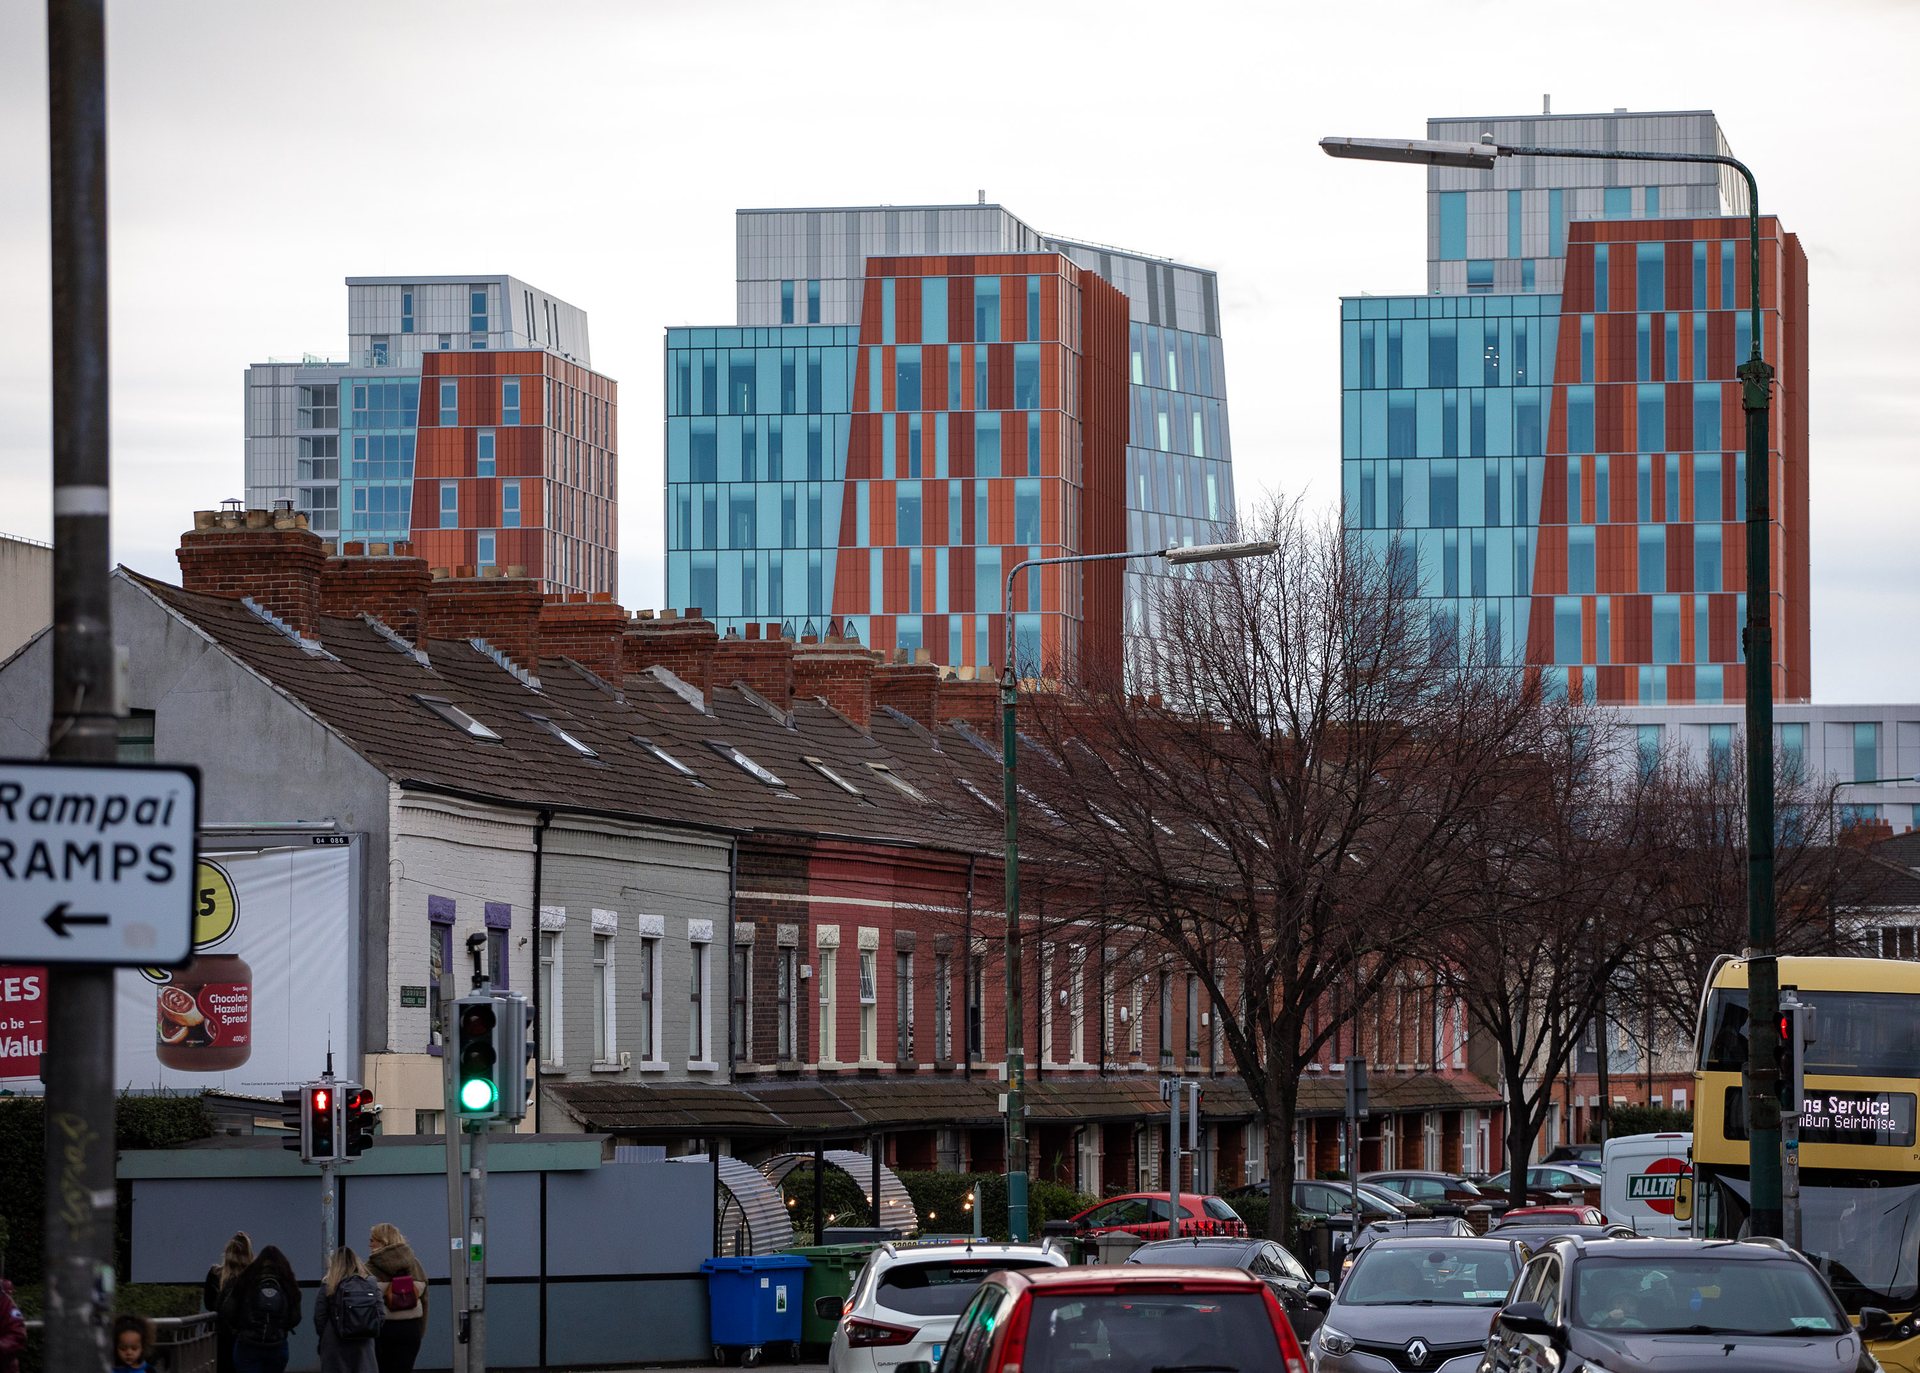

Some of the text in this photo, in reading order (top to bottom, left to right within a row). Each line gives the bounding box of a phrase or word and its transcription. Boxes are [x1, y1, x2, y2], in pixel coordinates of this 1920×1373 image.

[0, 840, 175, 883] RAMPS
[209, 994, 248, 1004] Chocolate
[213, 1004, 248, 1014] Hazelnut
[10, 1018, 24, 1029] be
[221, 1014, 248, 1026] Spread
[1828, 1096, 1890, 1115] Service
